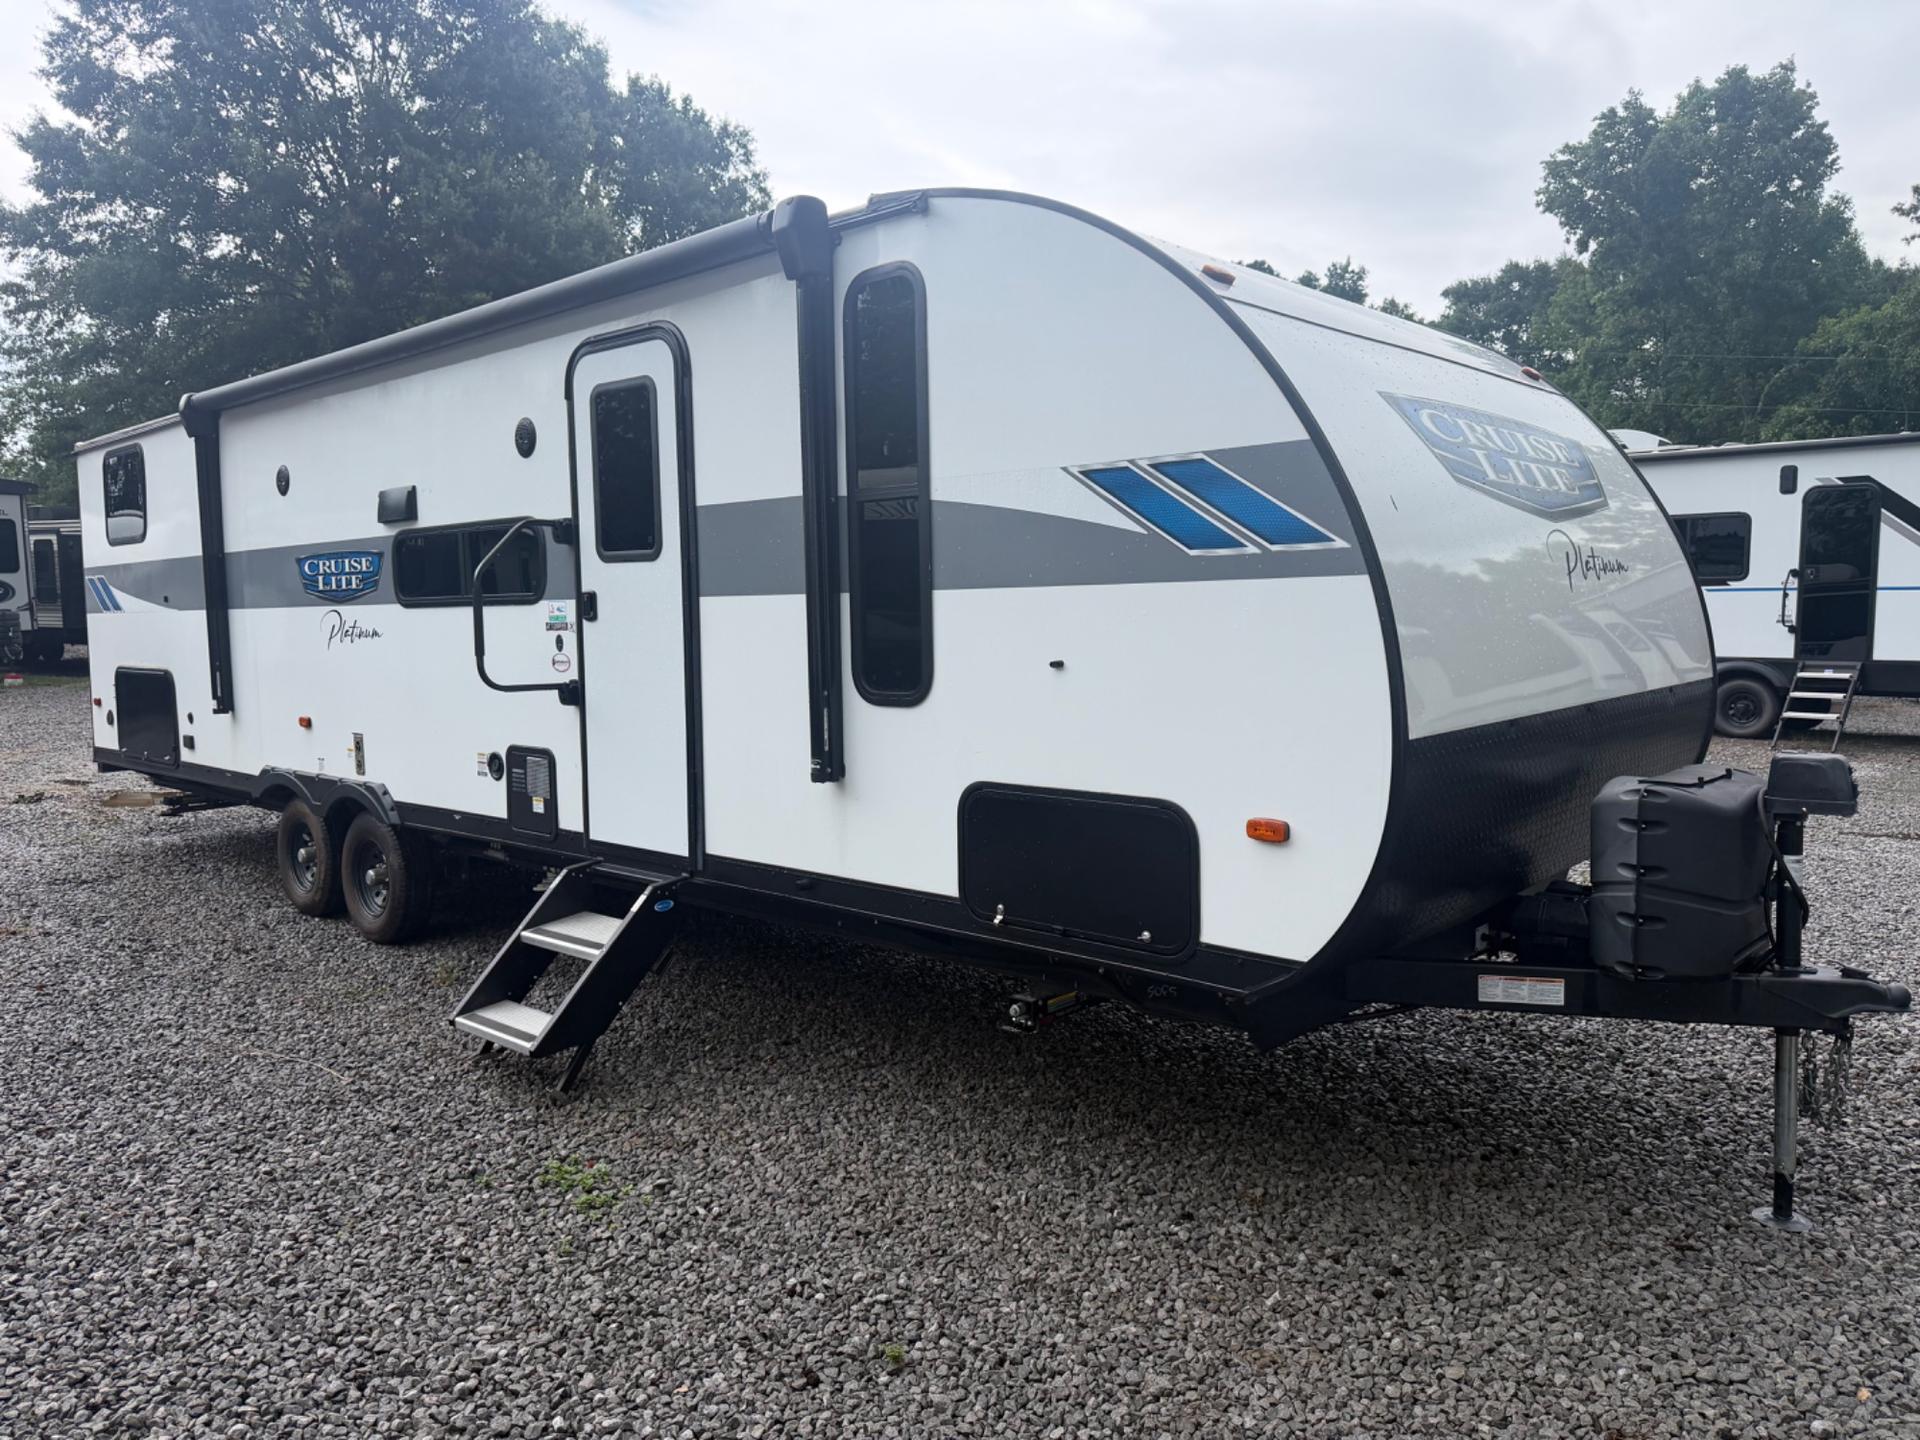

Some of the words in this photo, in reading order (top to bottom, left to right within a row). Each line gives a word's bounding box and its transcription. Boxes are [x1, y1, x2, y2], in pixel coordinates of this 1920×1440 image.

[1418, 408, 1581, 468] CRUISE
[1468, 447, 1580, 495] LITE
[303, 556, 374, 576] CRUISE
[316, 573, 364, 591] LITE
[1546, 529, 1630, 593] Platinum
[320, 608, 384, 651] Platinum
